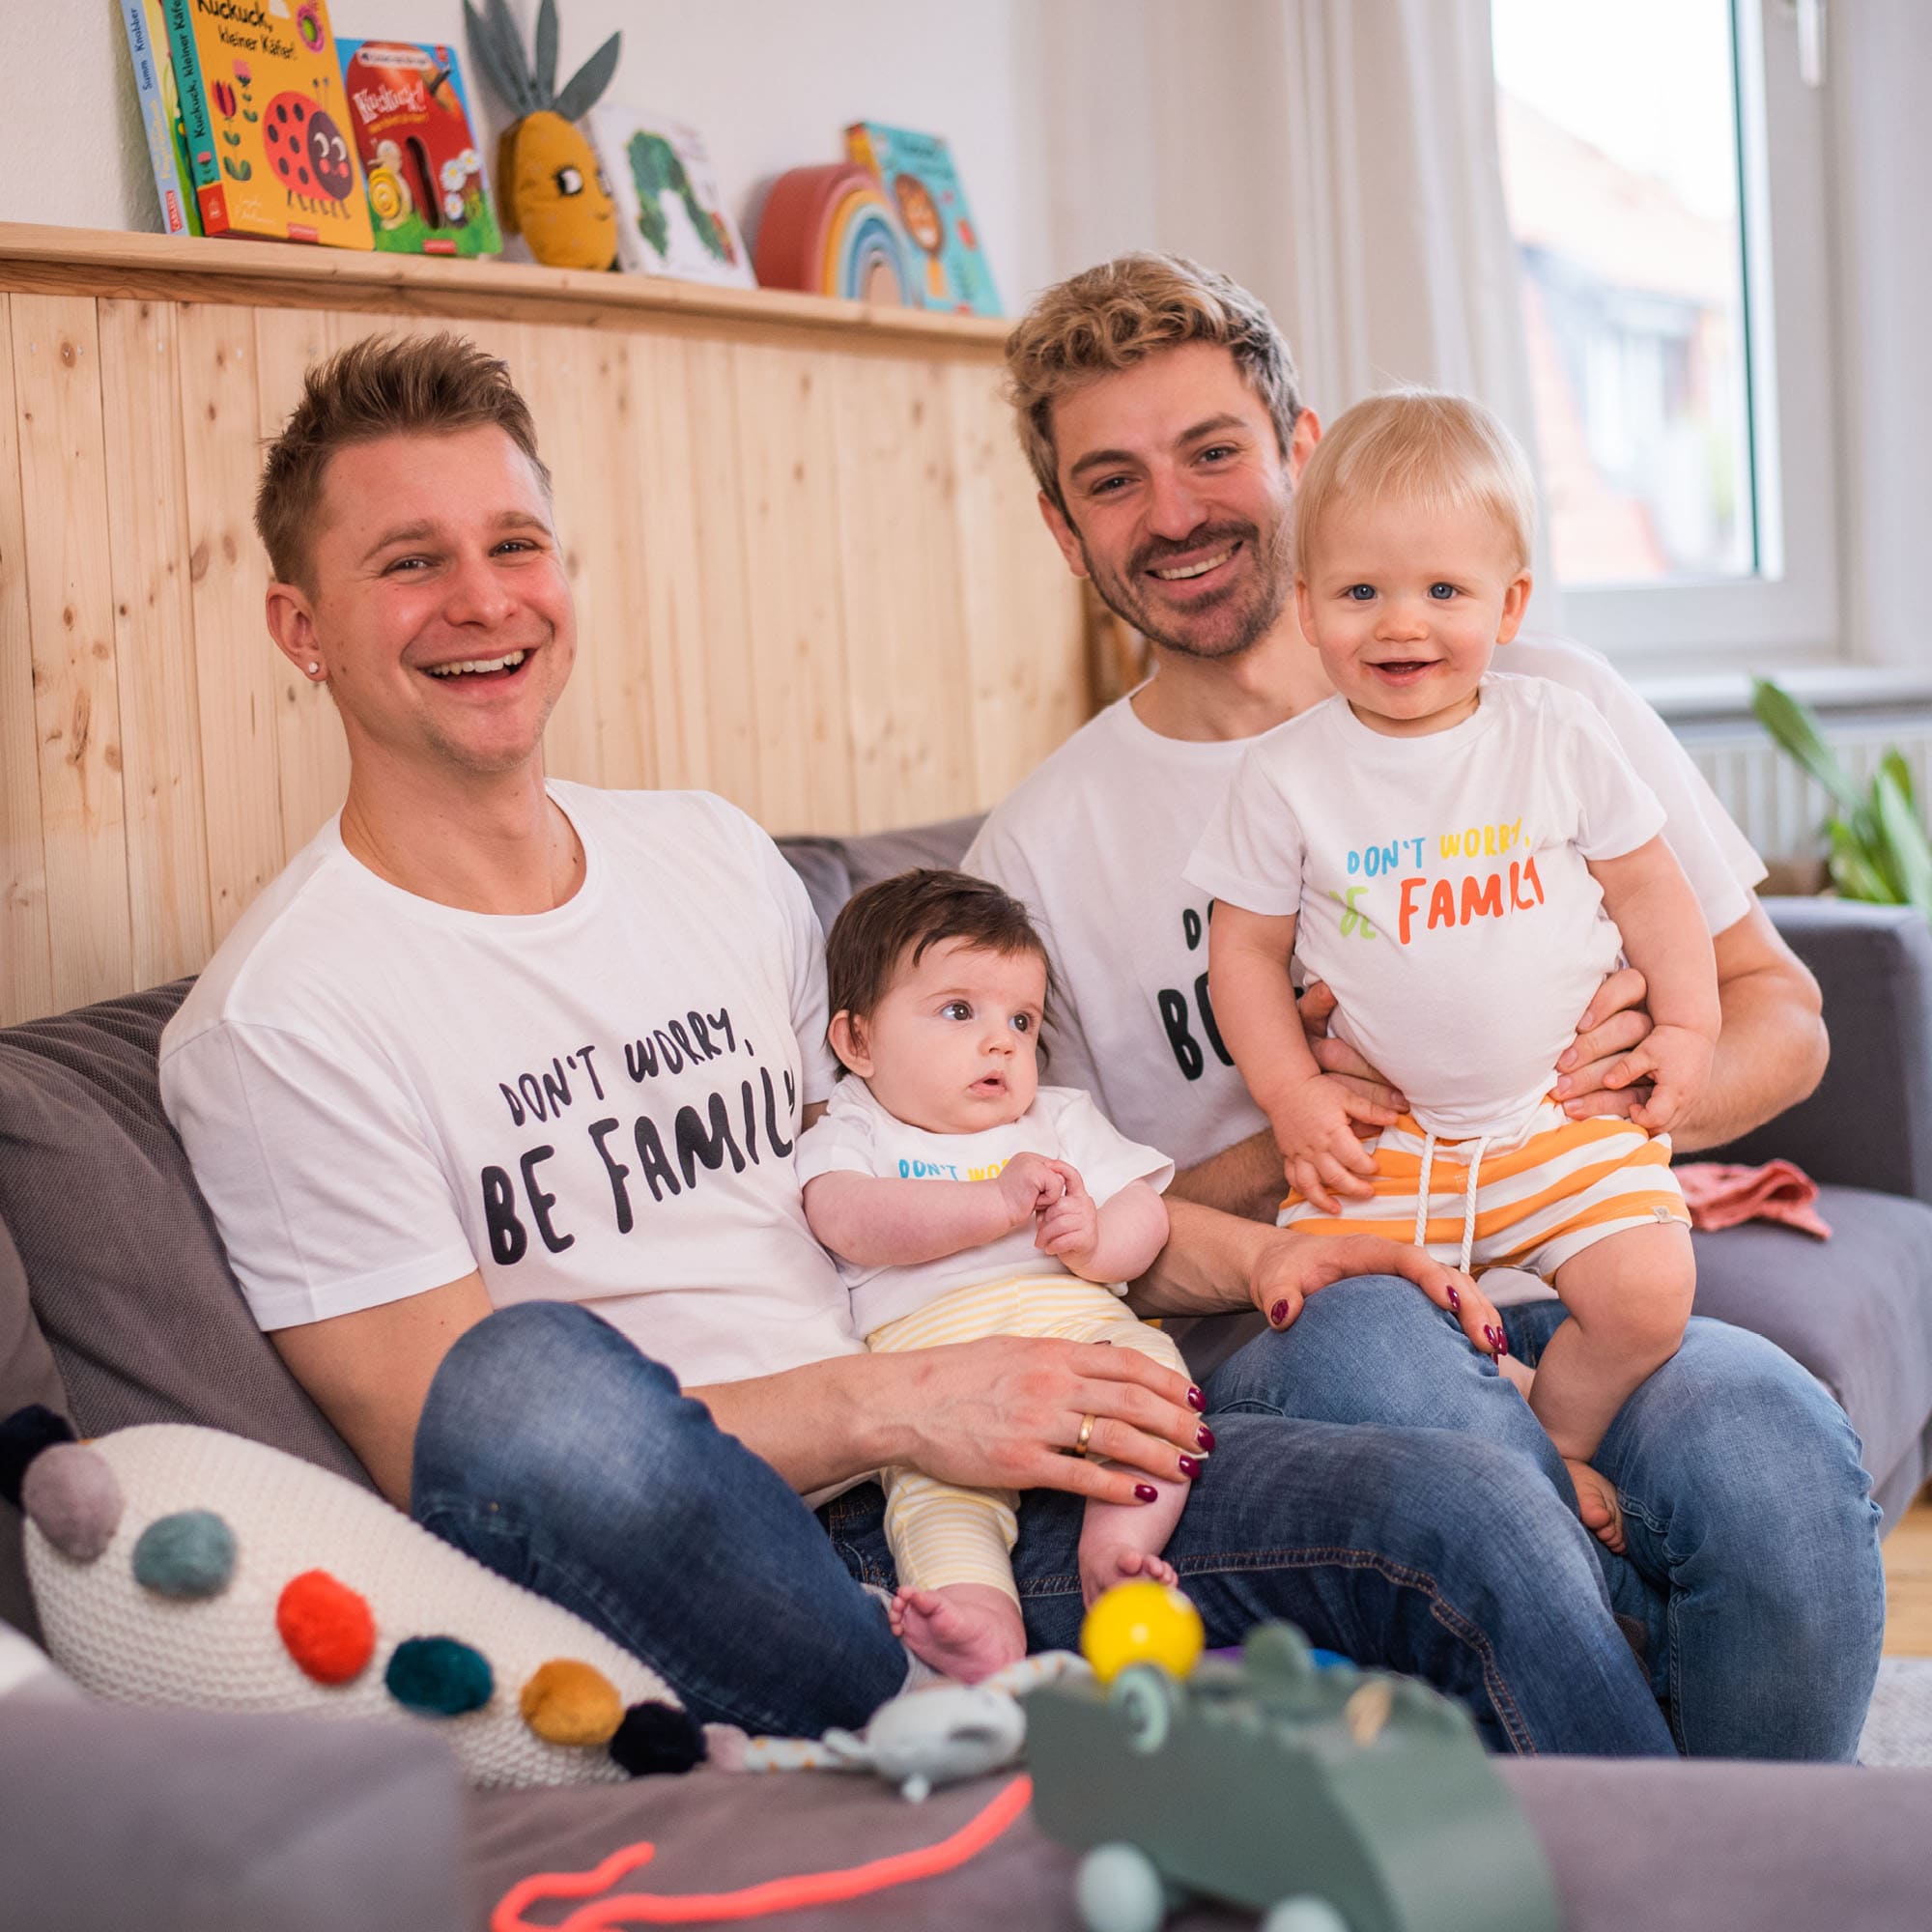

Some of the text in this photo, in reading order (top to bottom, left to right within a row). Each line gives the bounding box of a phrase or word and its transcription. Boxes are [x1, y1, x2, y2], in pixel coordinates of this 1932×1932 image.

[179, 34, 194, 78] kleiner
[217, 23, 298, 61] kleiner Käfer!
[1347, 816, 1530, 878] DON'T WORRY,
[498, 1007, 754, 1127] DON'T WORRY,
[898, 1158, 1010, 1181] DON'T WO
[481, 1144, 576, 1266] BE
